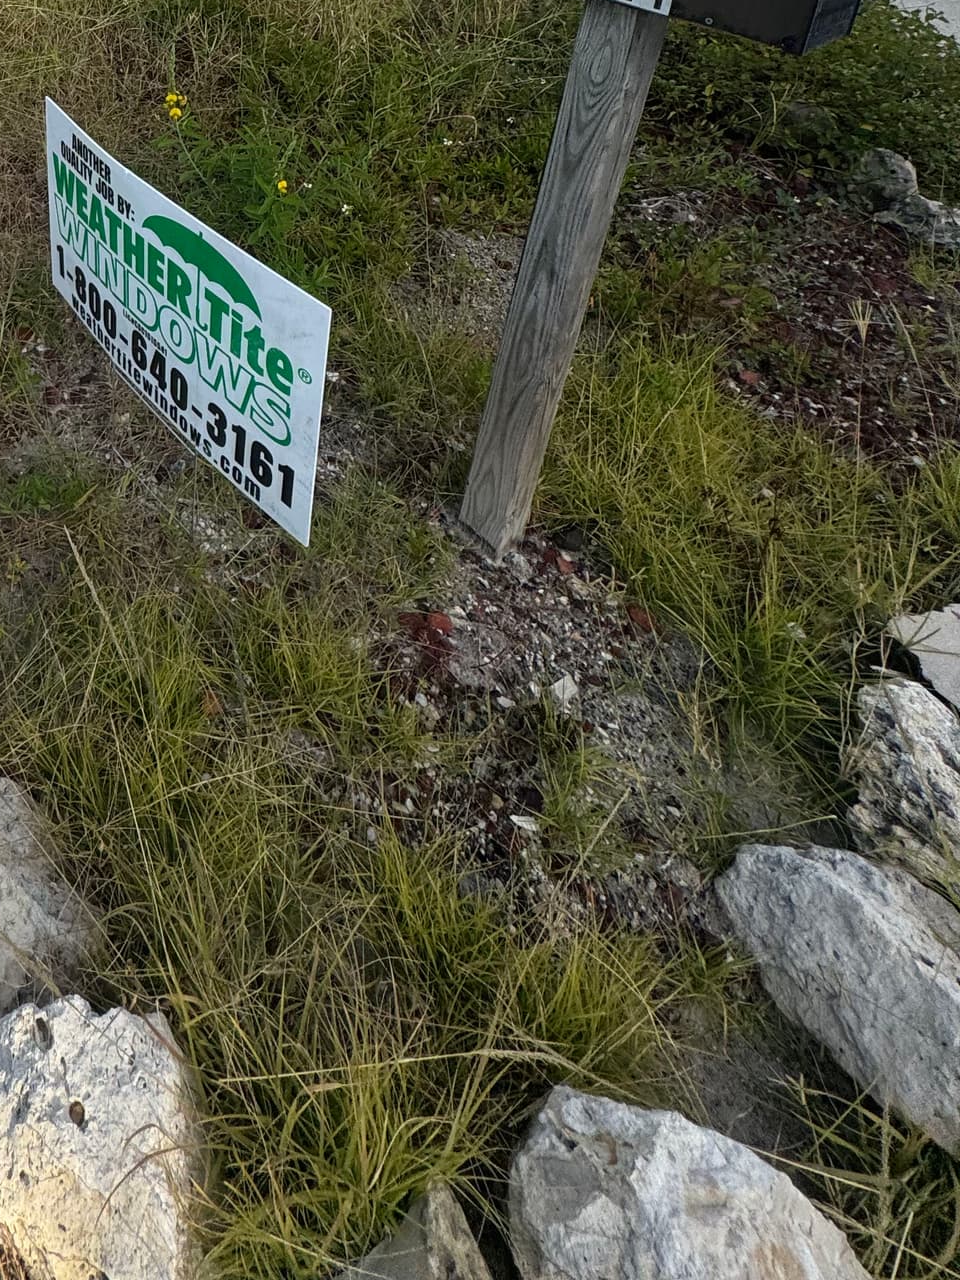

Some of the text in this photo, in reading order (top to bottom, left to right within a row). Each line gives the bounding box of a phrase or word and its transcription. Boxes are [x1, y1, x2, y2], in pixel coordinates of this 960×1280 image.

[61, 141, 135, 222] QUALITY JOB BY:
[72, 133, 111, 185] ANOTHER
[52, 151, 294, 396] WEATHER Tite
[54, 194, 291, 447] WINDOWS
[56, 245, 295, 508] 1-800-640-3161
[71, 293, 262, 503] weathertitewindows.com
